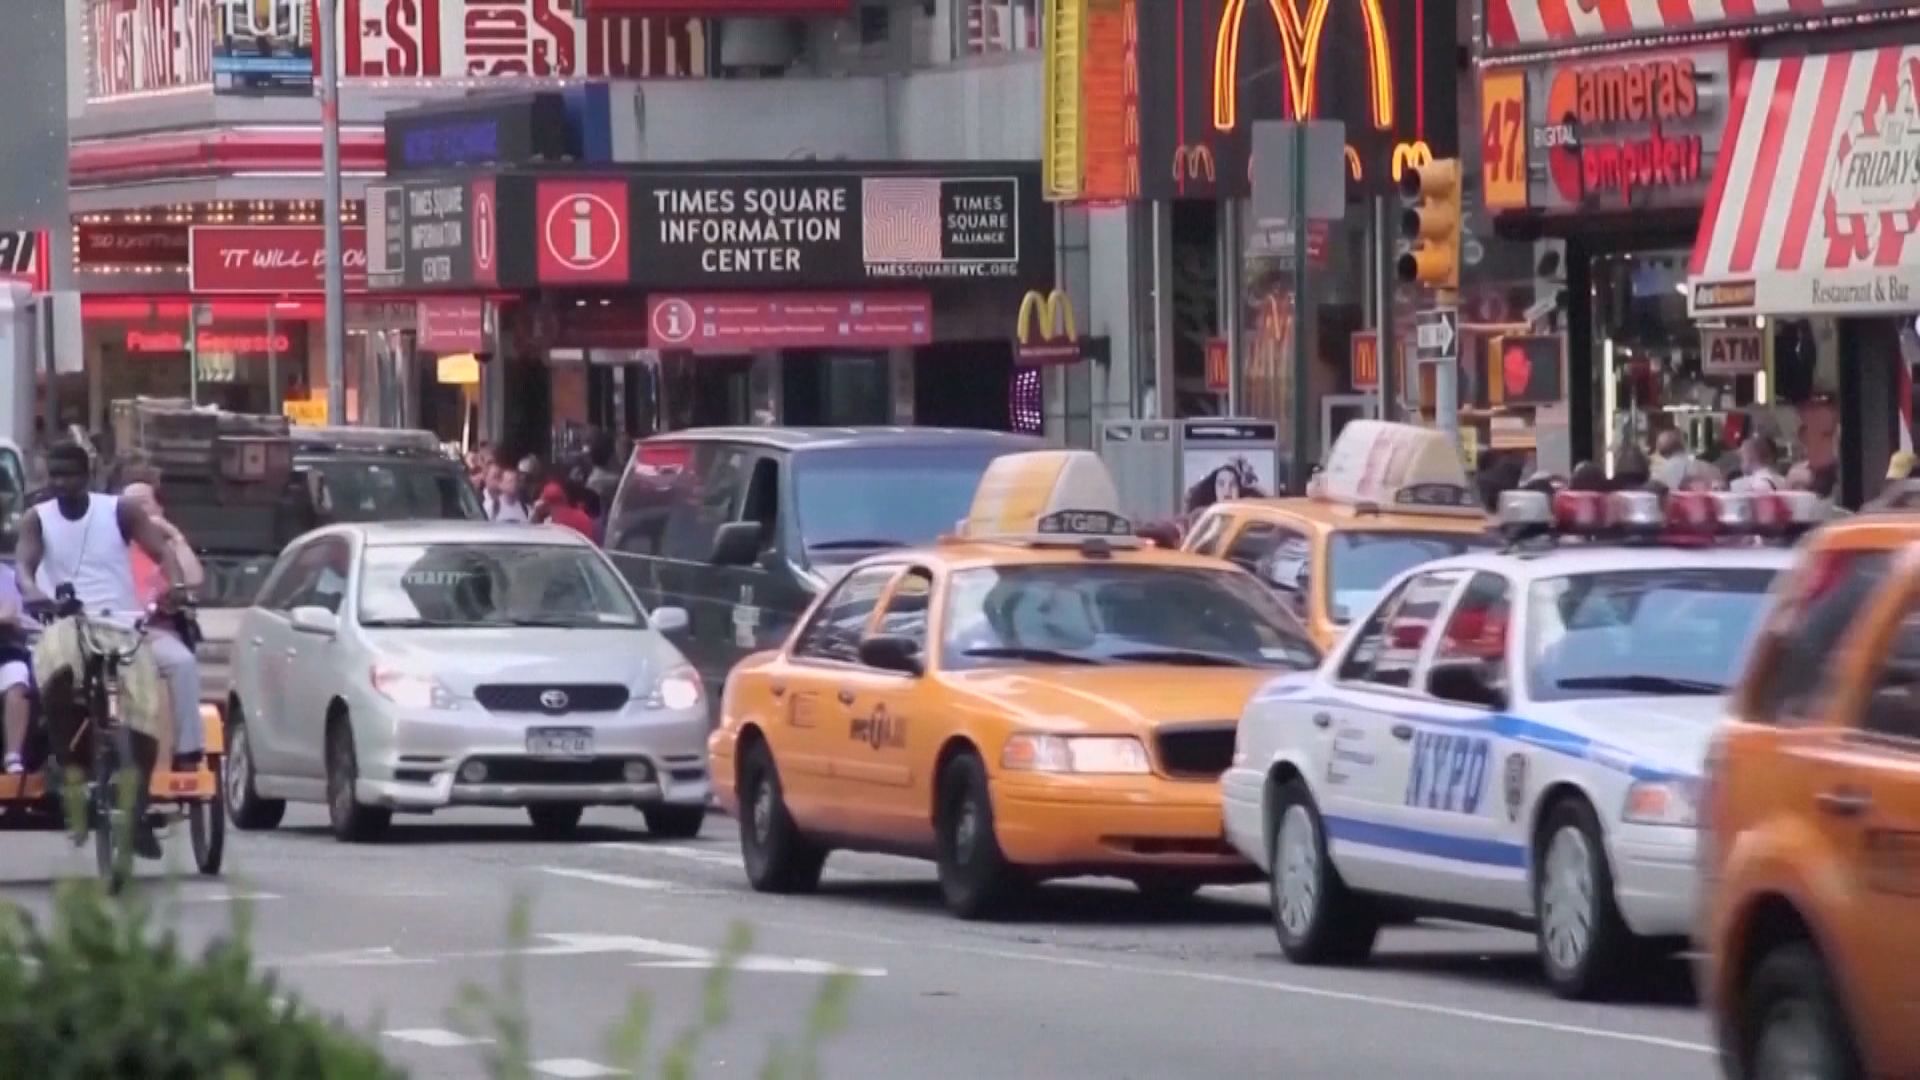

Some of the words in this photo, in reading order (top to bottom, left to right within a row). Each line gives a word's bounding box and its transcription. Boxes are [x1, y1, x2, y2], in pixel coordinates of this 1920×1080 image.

[653, 189, 735, 213] TIMES
[744, 188, 847, 215] SQUARE
[953, 196, 1003, 211] TIMES
[660, 218, 841, 242] INFORMATION
[947, 213, 1008, 231] SQUARE
[951, 231, 1006, 244] ALLIANCE
[252, 249, 309, 268] WILL
[702, 248, 801, 272] CENTER
[1812, 278, 1872, 305] Restaurant
[1710, 336, 1762, 362] ATM
[1405, 729, 1490, 814] NYPD
